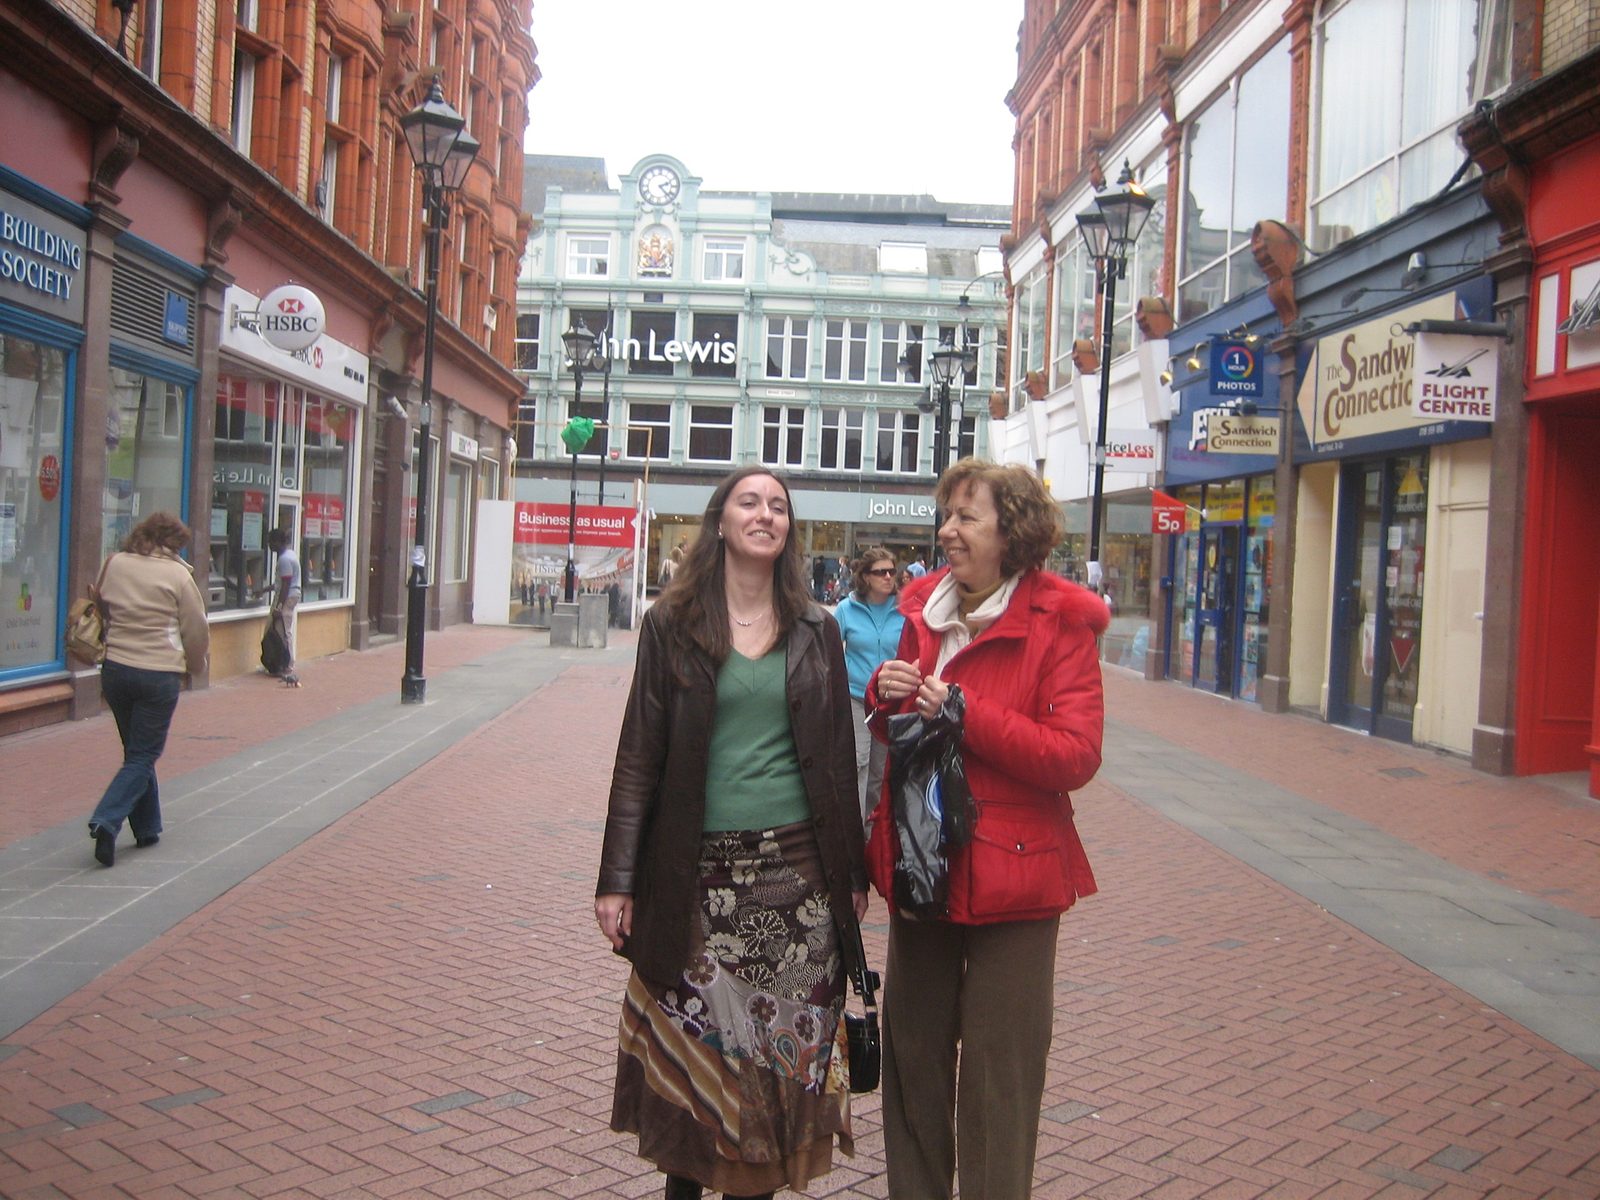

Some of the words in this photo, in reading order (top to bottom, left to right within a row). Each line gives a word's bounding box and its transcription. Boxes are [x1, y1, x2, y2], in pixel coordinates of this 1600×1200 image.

[3, 212, 81, 270] BUILDING
[1, 250, 73, 300] SOCIETY
[266, 315, 318, 333] HSBC
[649, 328, 736, 364] Lewis
[1233, 353, 1240, 365] 1
[1326, 366, 1342, 381] The
[1339, 334, 1414, 392] Sandwi
[1217, 381, 1256, 391] PHOTOS
[1422, 384, 1489, 400] FLIGHT
[1323, 371, 1413, 437] Connectio
[1419, 400, 1491, 416] CENTRE
[1220, 420, 1277, 436] Sandwich
[1211, 435, 1272, 450] Connection
[867, 498, 906, 519] John
[910, 500, 937, 517] Lew
[519, 511, 572, 525] Business
[576, 517, 590, 527] as
[592, 516, 626, 529] usual
[1158, 511, 1180, 532] 5p
